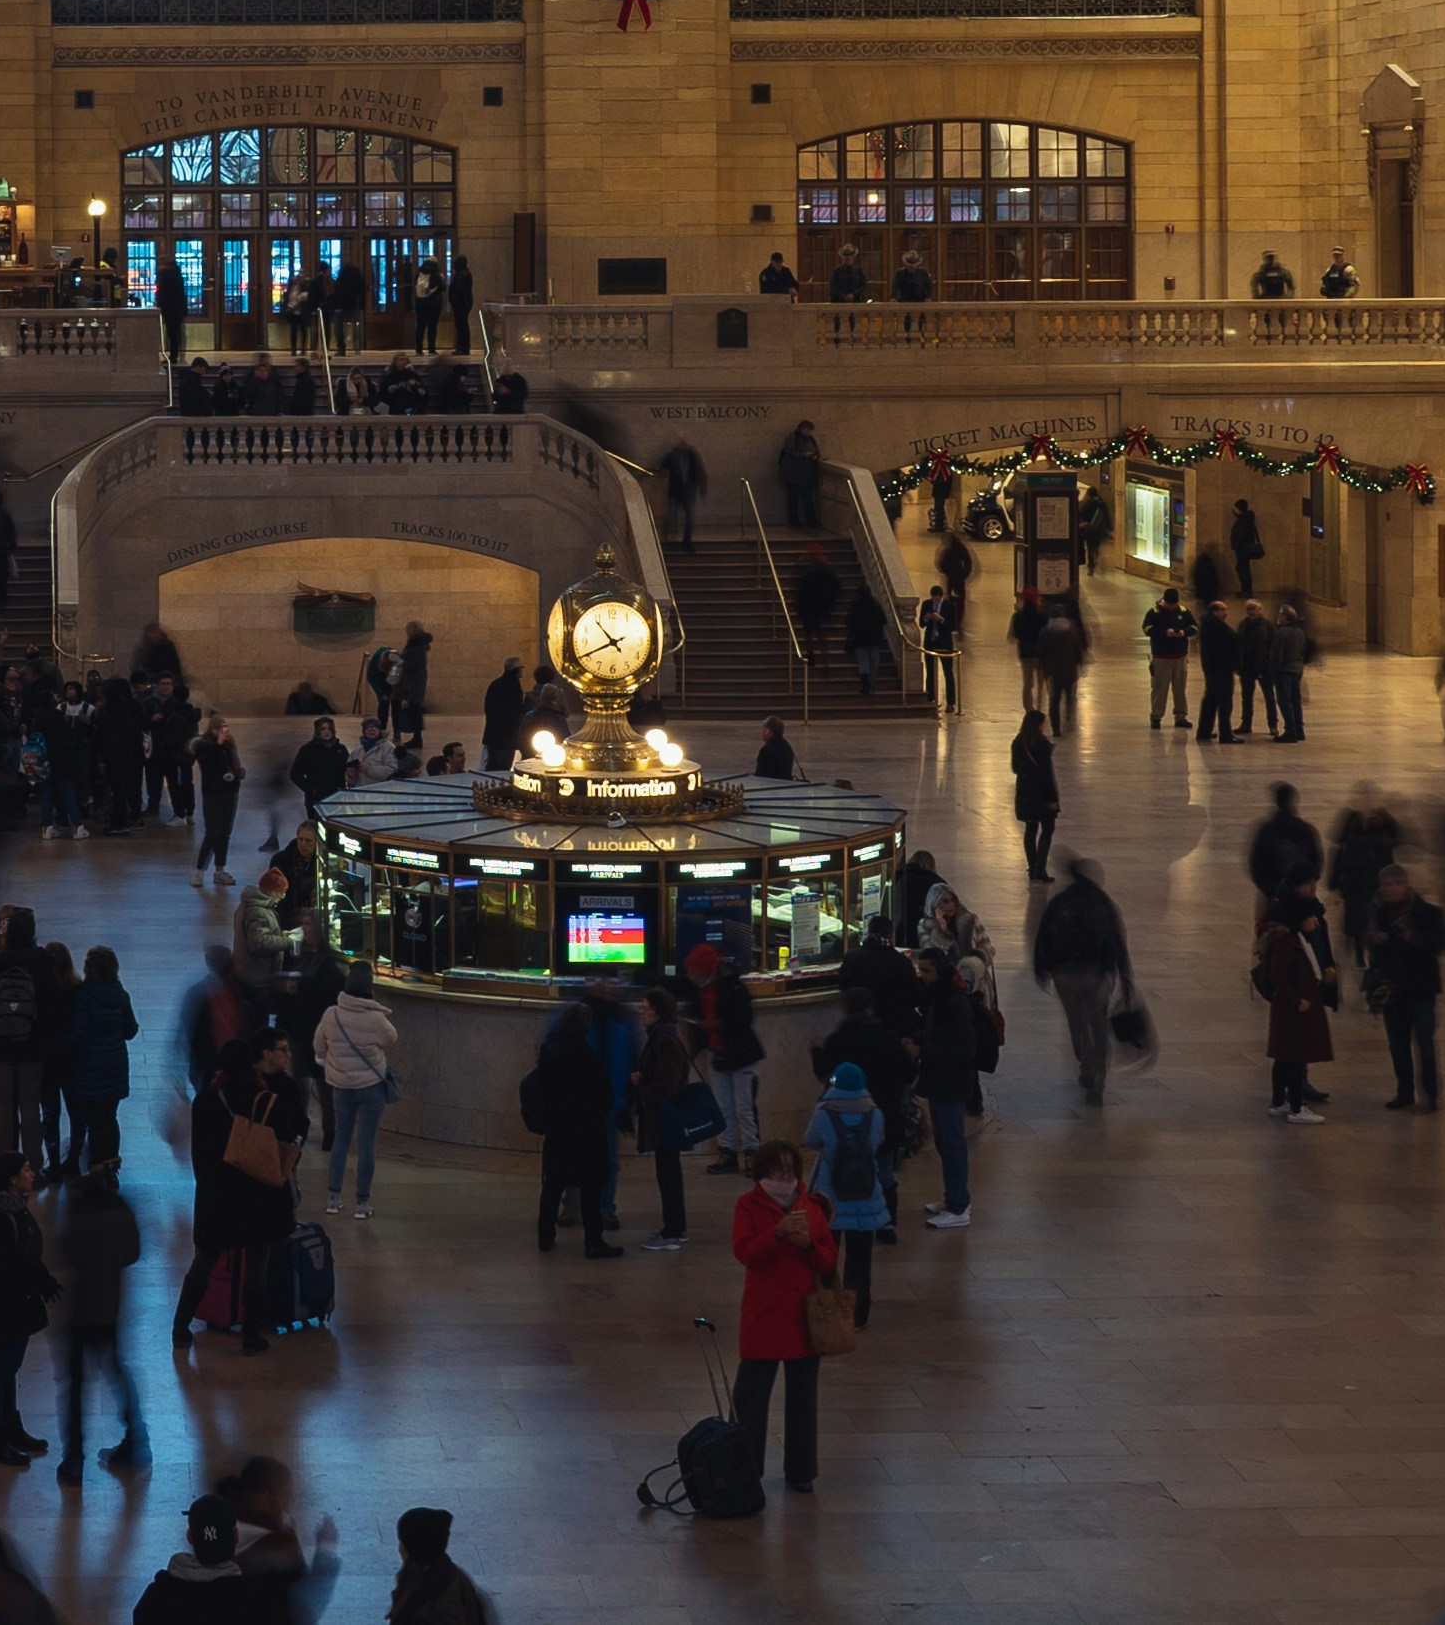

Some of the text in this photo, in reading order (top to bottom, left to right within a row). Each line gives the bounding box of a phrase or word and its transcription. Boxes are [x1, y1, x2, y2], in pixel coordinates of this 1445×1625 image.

[155, 84, 423, 113] TO VANDERBILT AVENUE
[140, 101, 439, 135] THE CAMPBELL APARTMENT
[650, 406, 771, 419] WEST BALCONY
[909, 417, 1096, 456] TICKET MACHINES
[1171, 416, 1250, 436] TRACKS
[1256, 422, 1274, 437] 31
[1281, 426, 1309, 444] TO
[167, 522, 509, 563] DINING CONCOURSE TRACKS 100 TO 117
[587, 779, 675, 798] Information
[583, 898, 631, 906] ARRIVALS
[204, 1526, 218, 1541] NY
